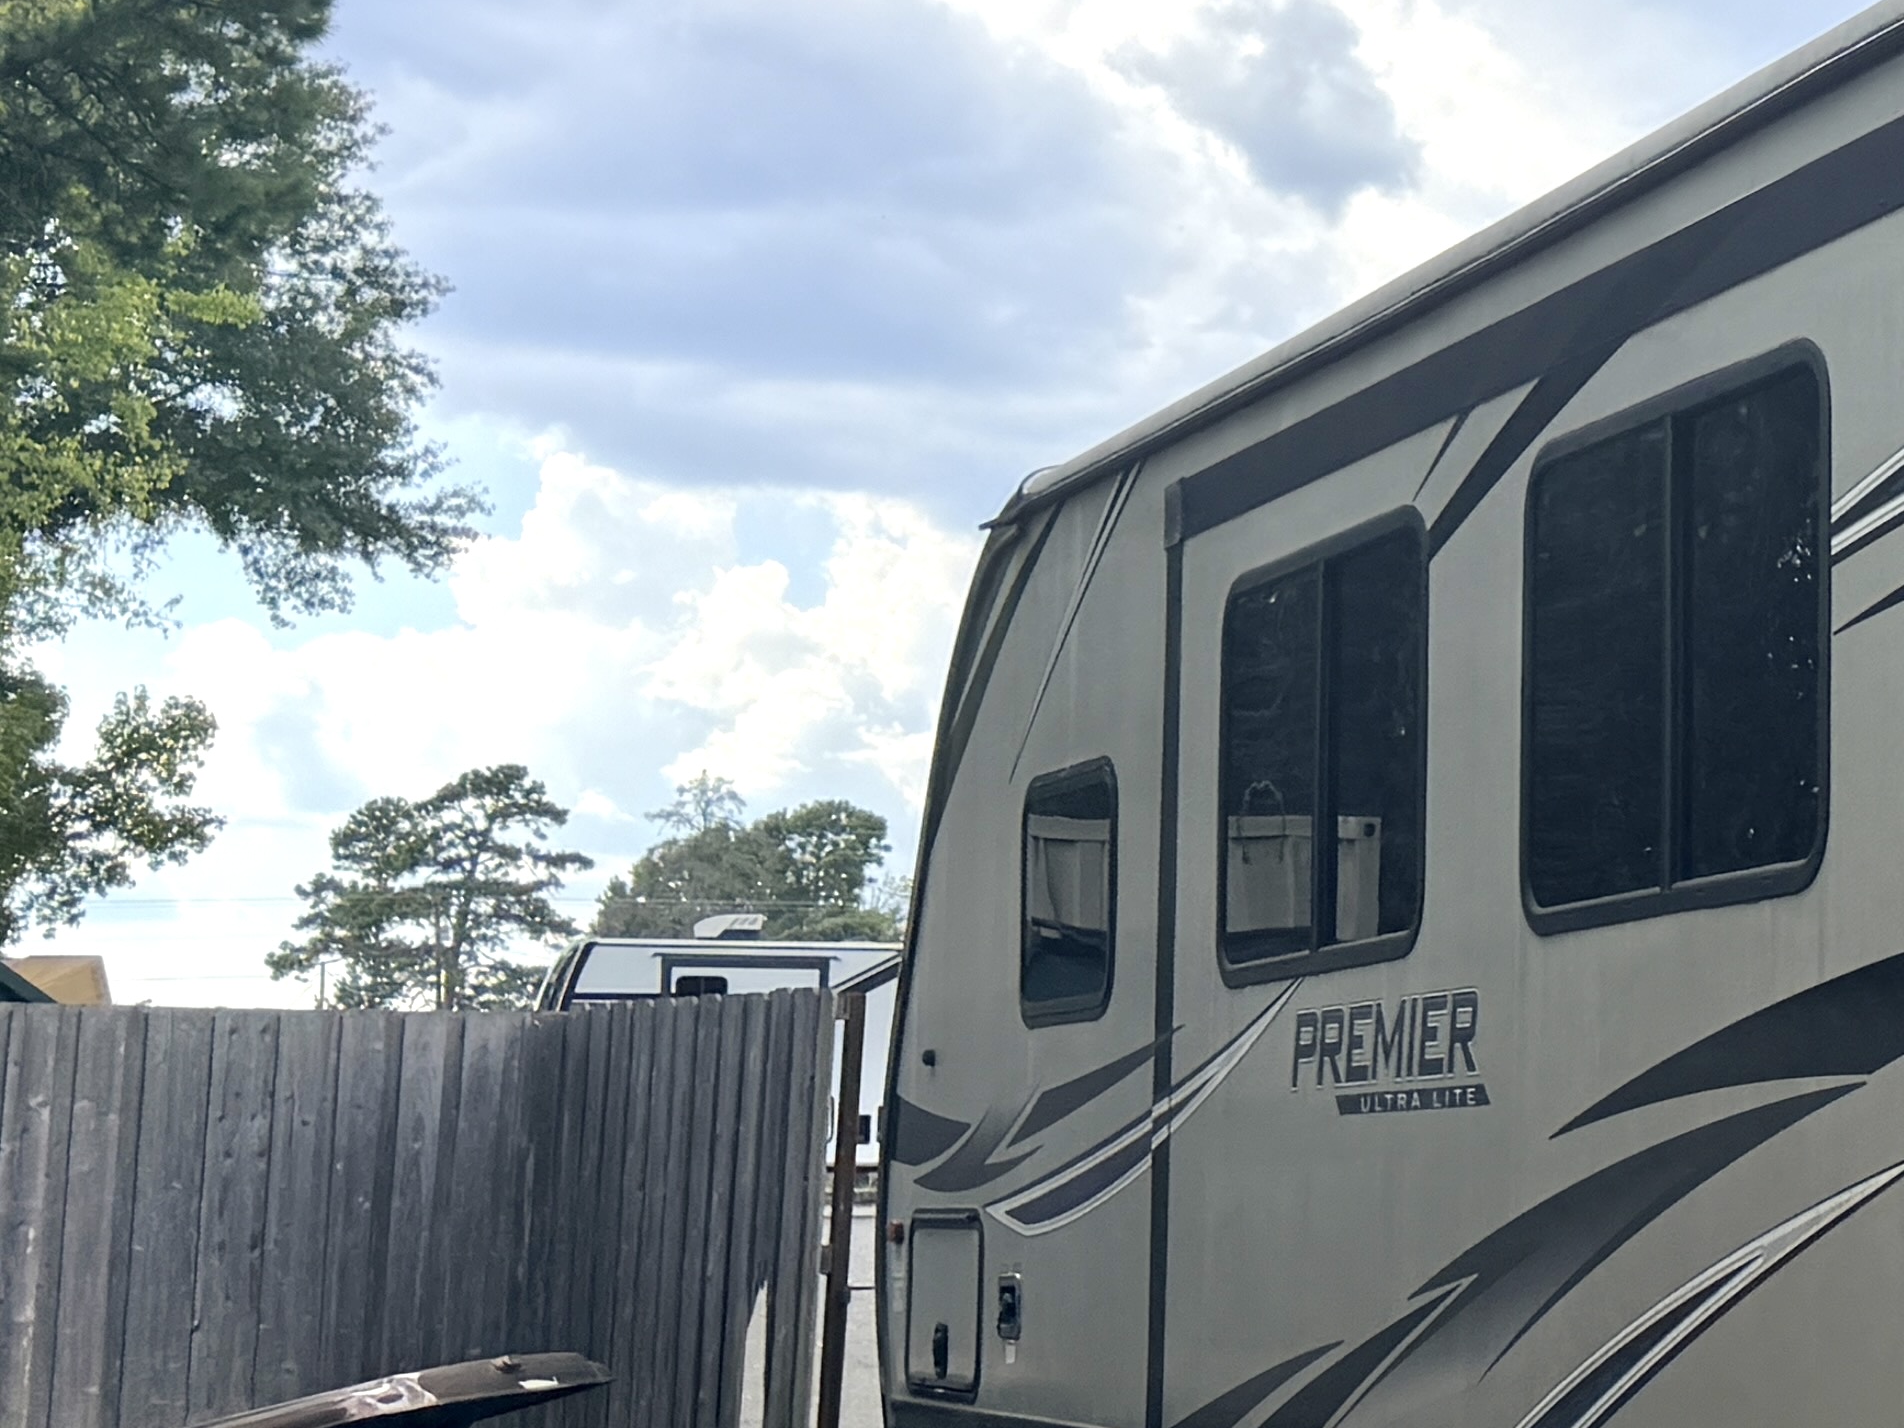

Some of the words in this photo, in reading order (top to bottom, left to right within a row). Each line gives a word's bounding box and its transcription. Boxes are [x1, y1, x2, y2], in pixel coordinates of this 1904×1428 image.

[1290, 986, 1480, 1093] PREMIER
[1360, 1092, 1421, 1113] ULTRA
[1432, 1088, 1477, 1107] LITE
